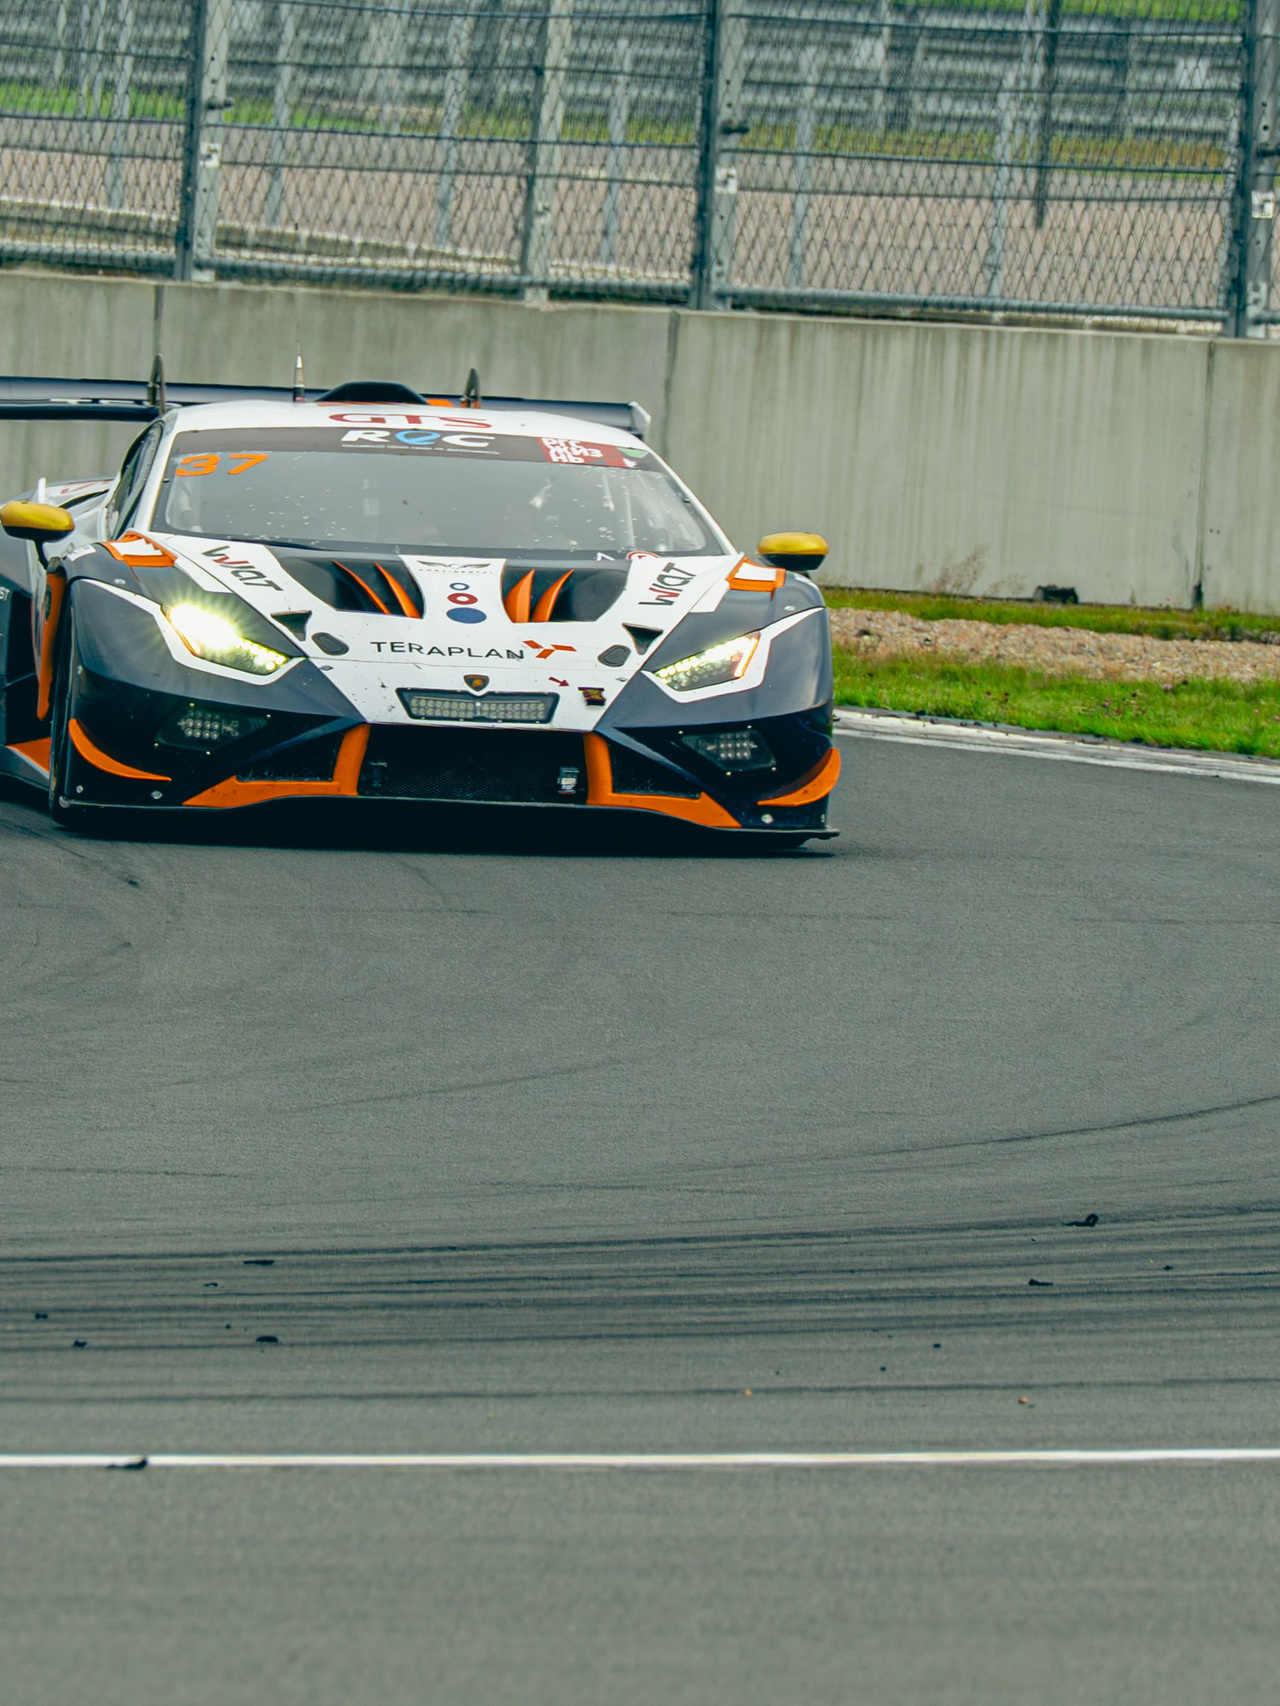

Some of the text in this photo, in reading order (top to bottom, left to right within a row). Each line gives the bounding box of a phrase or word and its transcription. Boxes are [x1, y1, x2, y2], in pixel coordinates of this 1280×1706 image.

[328, 413, 493, 429] GTS
[175, 454, 269, 477] 37
[370, 641, 525, 660] TERAPLAN
